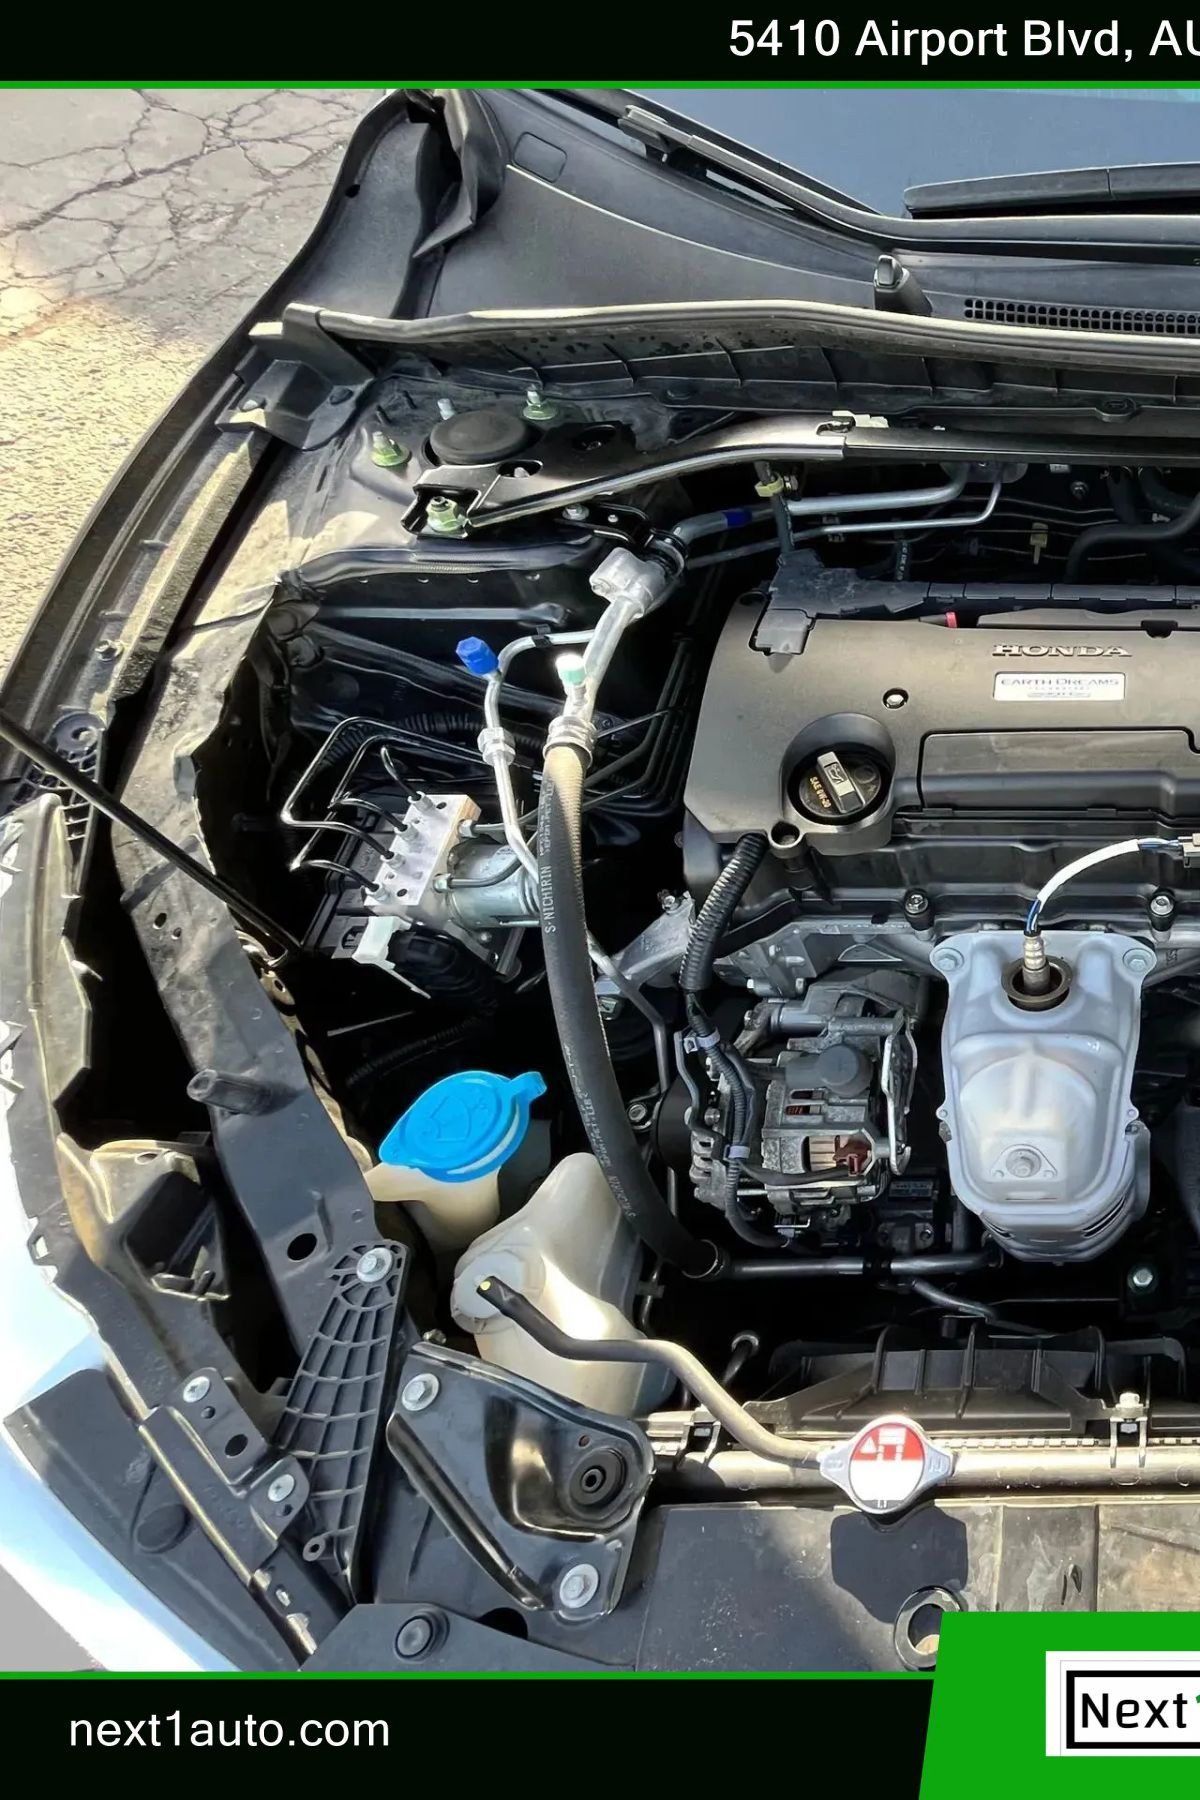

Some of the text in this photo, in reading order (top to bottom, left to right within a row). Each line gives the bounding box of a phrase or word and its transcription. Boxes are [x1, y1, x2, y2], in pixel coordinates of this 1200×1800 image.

[992, 643, 1132, 657] HONDA
[1000, 677, 1052, 686] EARTH
[809, 775, 822, 791] SAE
